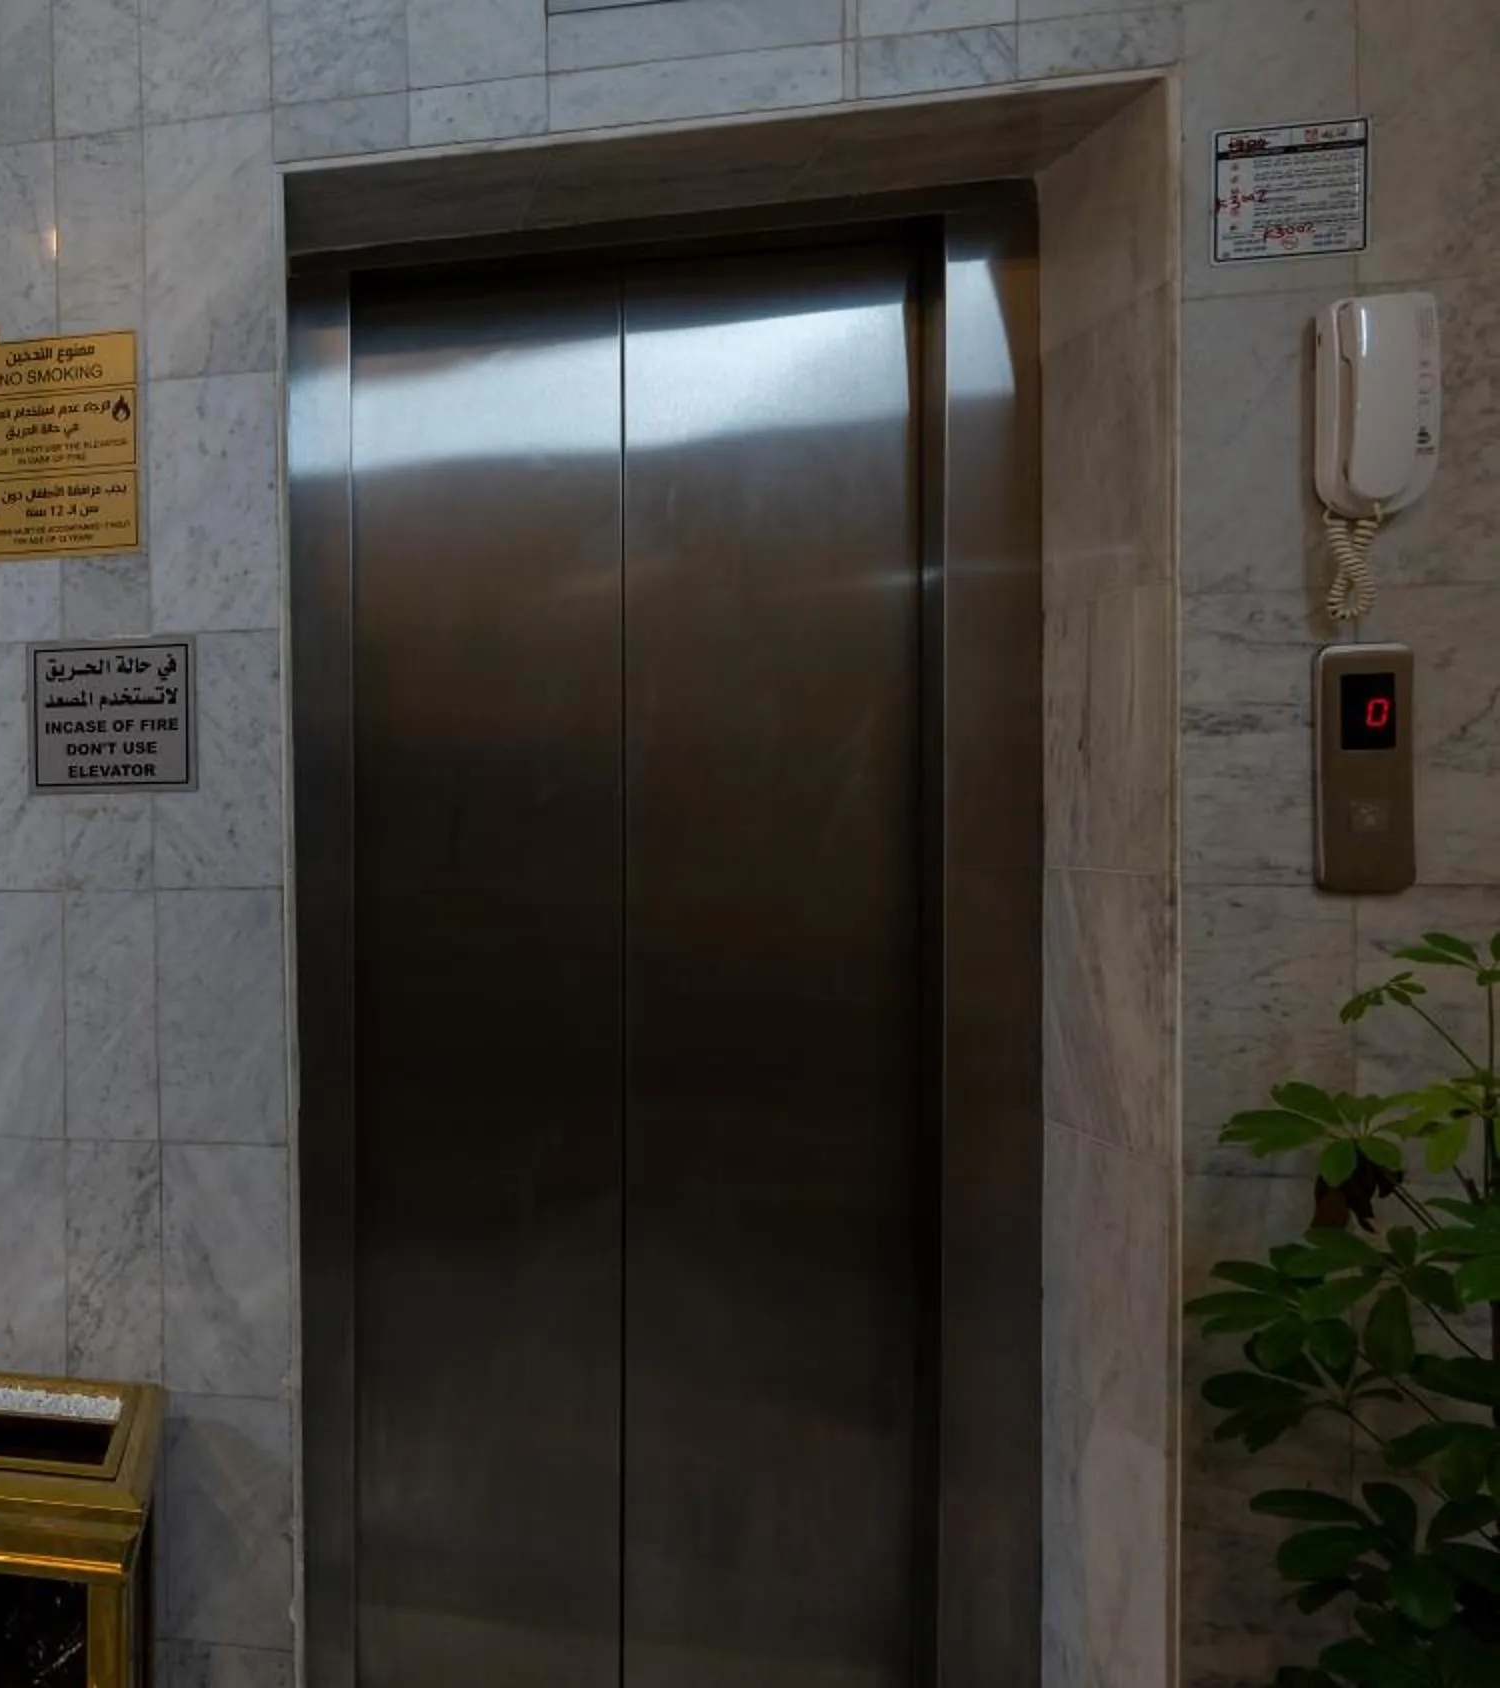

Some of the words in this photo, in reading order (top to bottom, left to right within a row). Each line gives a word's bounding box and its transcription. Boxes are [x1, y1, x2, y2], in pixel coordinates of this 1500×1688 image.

[5, 347, 53, 367] التدخين
[56, 344, 96, 364] ممنوع
[0, 371, 23, 387] NO
[26, 364, 104, 385] SMOKING
[57, 403, 80, 419] عدم
[83, 399, 111, 416] الرجاء
[5, 424, 38, 441] الحريق
[63, 423, 81, 439] في
[50, 505, 64, 517] 12
[45, 658, 112, 682] الحريق
[115, 655, 152, 674] حالة
[156, 653, 178, 682] في
[44, 689, 93, 709] المصعد
[1366, 698, 1389, 727] 0
[45, 719, 108, 735] INCASE
[111, 719, 135, 733] OF
[139, 717, 180, 732] FIRE
[66, 741, 117, 756] DON'T
[122, 741, 158, 755] USE
[67, 763, 156, 779] ELEVATOR
